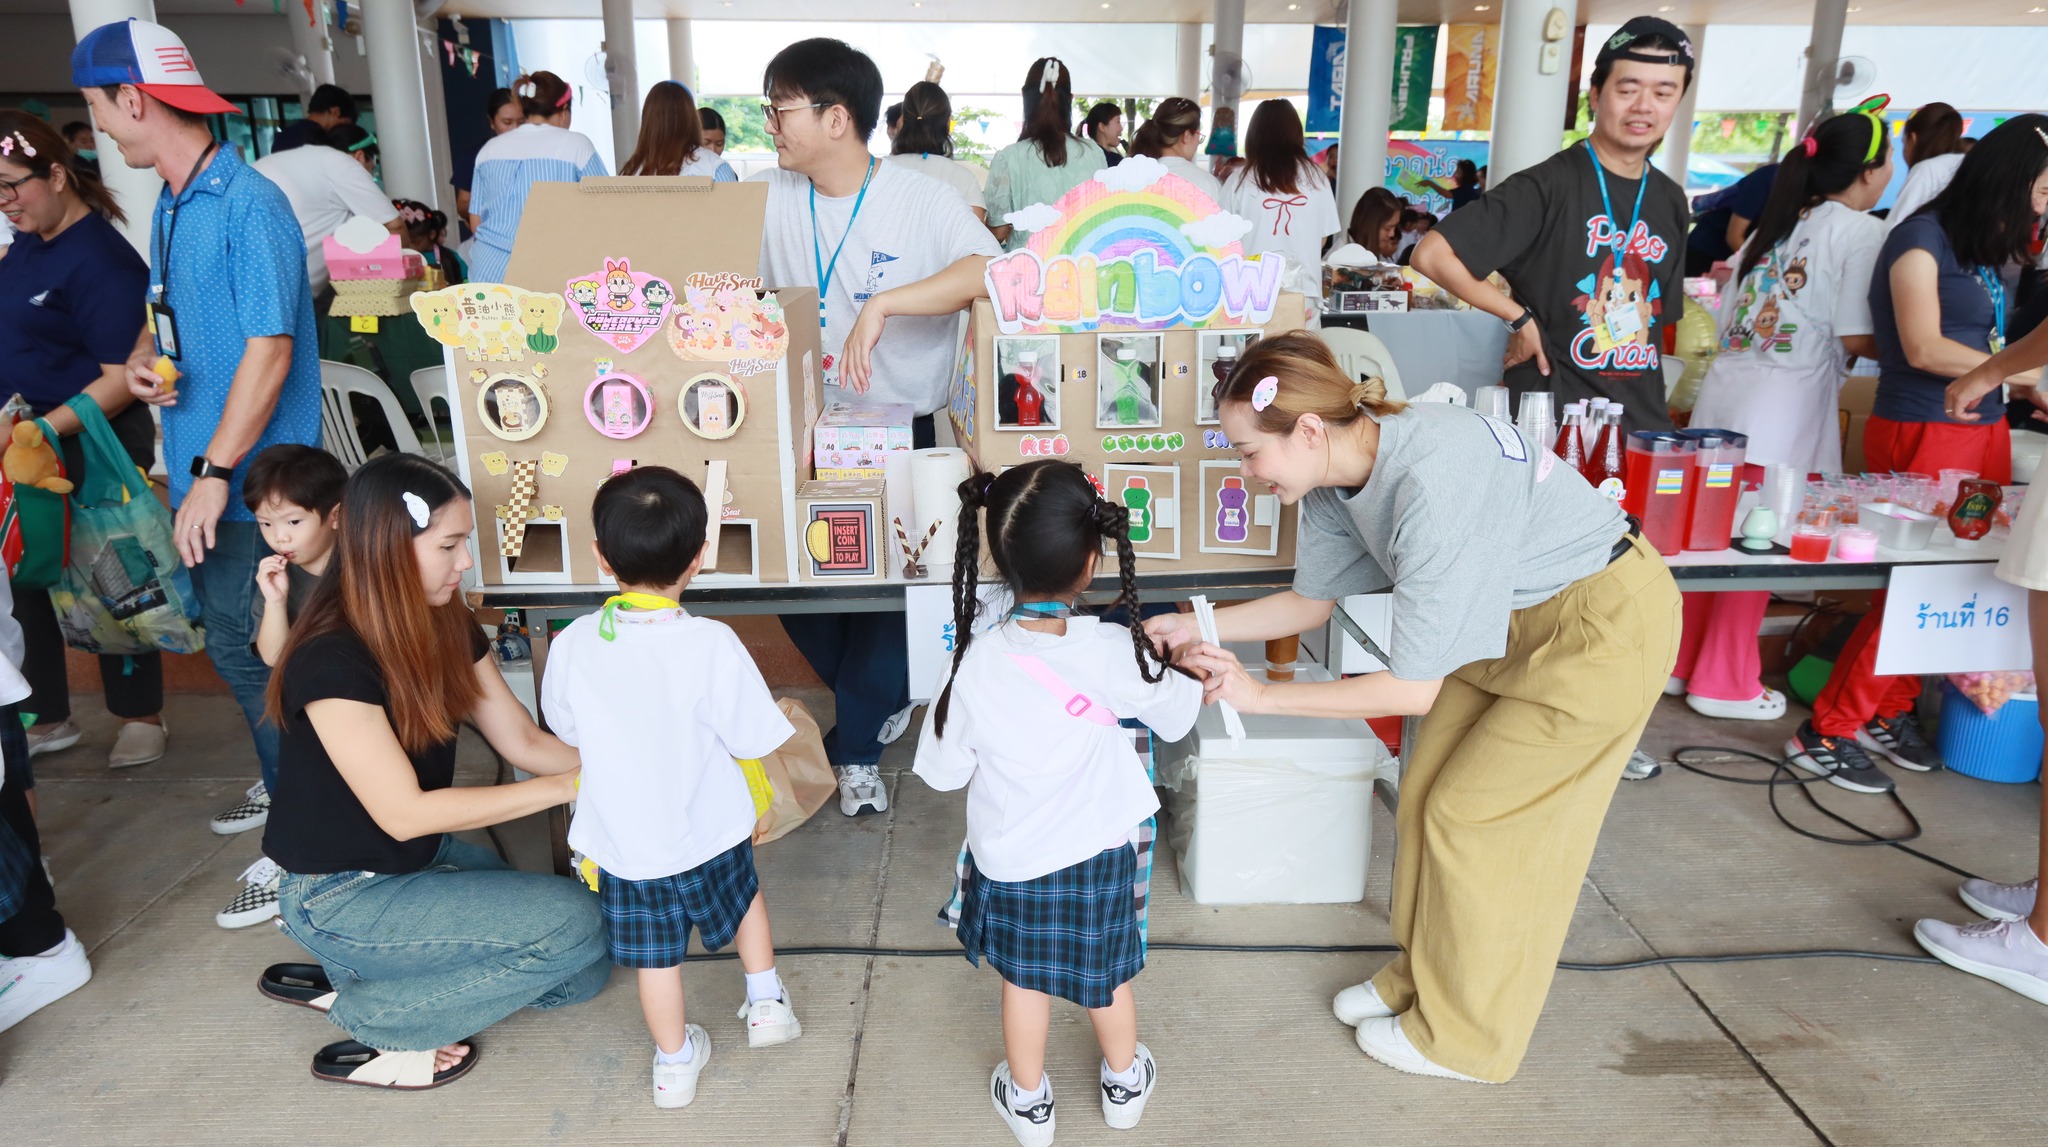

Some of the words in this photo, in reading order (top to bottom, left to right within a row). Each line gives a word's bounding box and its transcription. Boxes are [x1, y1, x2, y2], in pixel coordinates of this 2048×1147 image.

[1466, 30, 1485, 103] ARUNA
[687, 273, 729, 289] Have
[730, 274, 762, 291] Seat
[988, 250, 1280, 322] Rainbow
[729, 358, 756, 372] Have
[1020, 437, 1069, 456] RED
[1102, 432, 1184, 452] GREEN
[834, 525, 858, 536] INSERT
[837, 535, 856, 546] COIN
[835, 553, 845, 562] TO
[845, 552, 859, 562] PLAY
[1916, 592, 1978, 629] ร้านที่
[1984, 606, 2010, 627] 16
